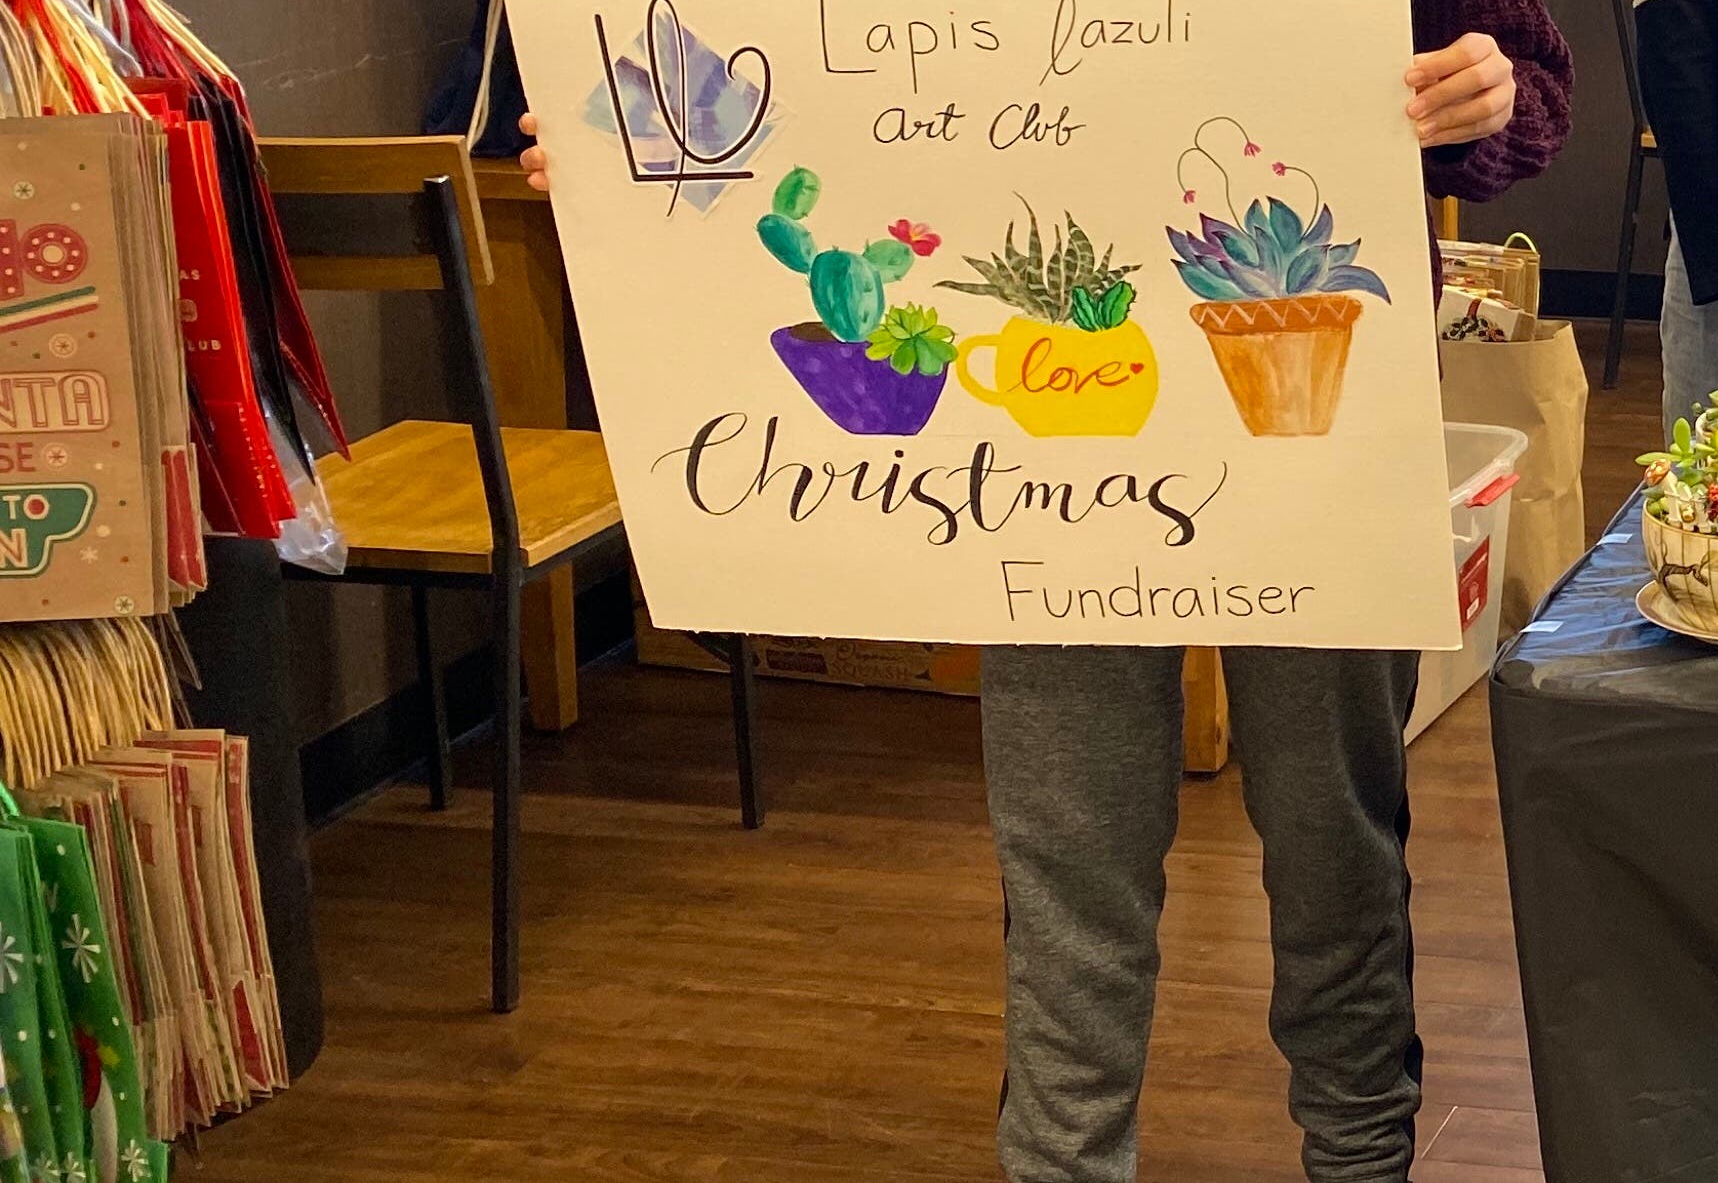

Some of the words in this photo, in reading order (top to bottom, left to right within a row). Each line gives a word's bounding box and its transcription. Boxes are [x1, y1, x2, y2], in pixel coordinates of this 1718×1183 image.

[989, 103, 1087, 150] Club
[1005, 337, 1129, 396] love
[2, 494, 50, 519] TO
[651, 412, 1228, 546] Christmas
[1001, 561, 1315, 622] Fundraiser
